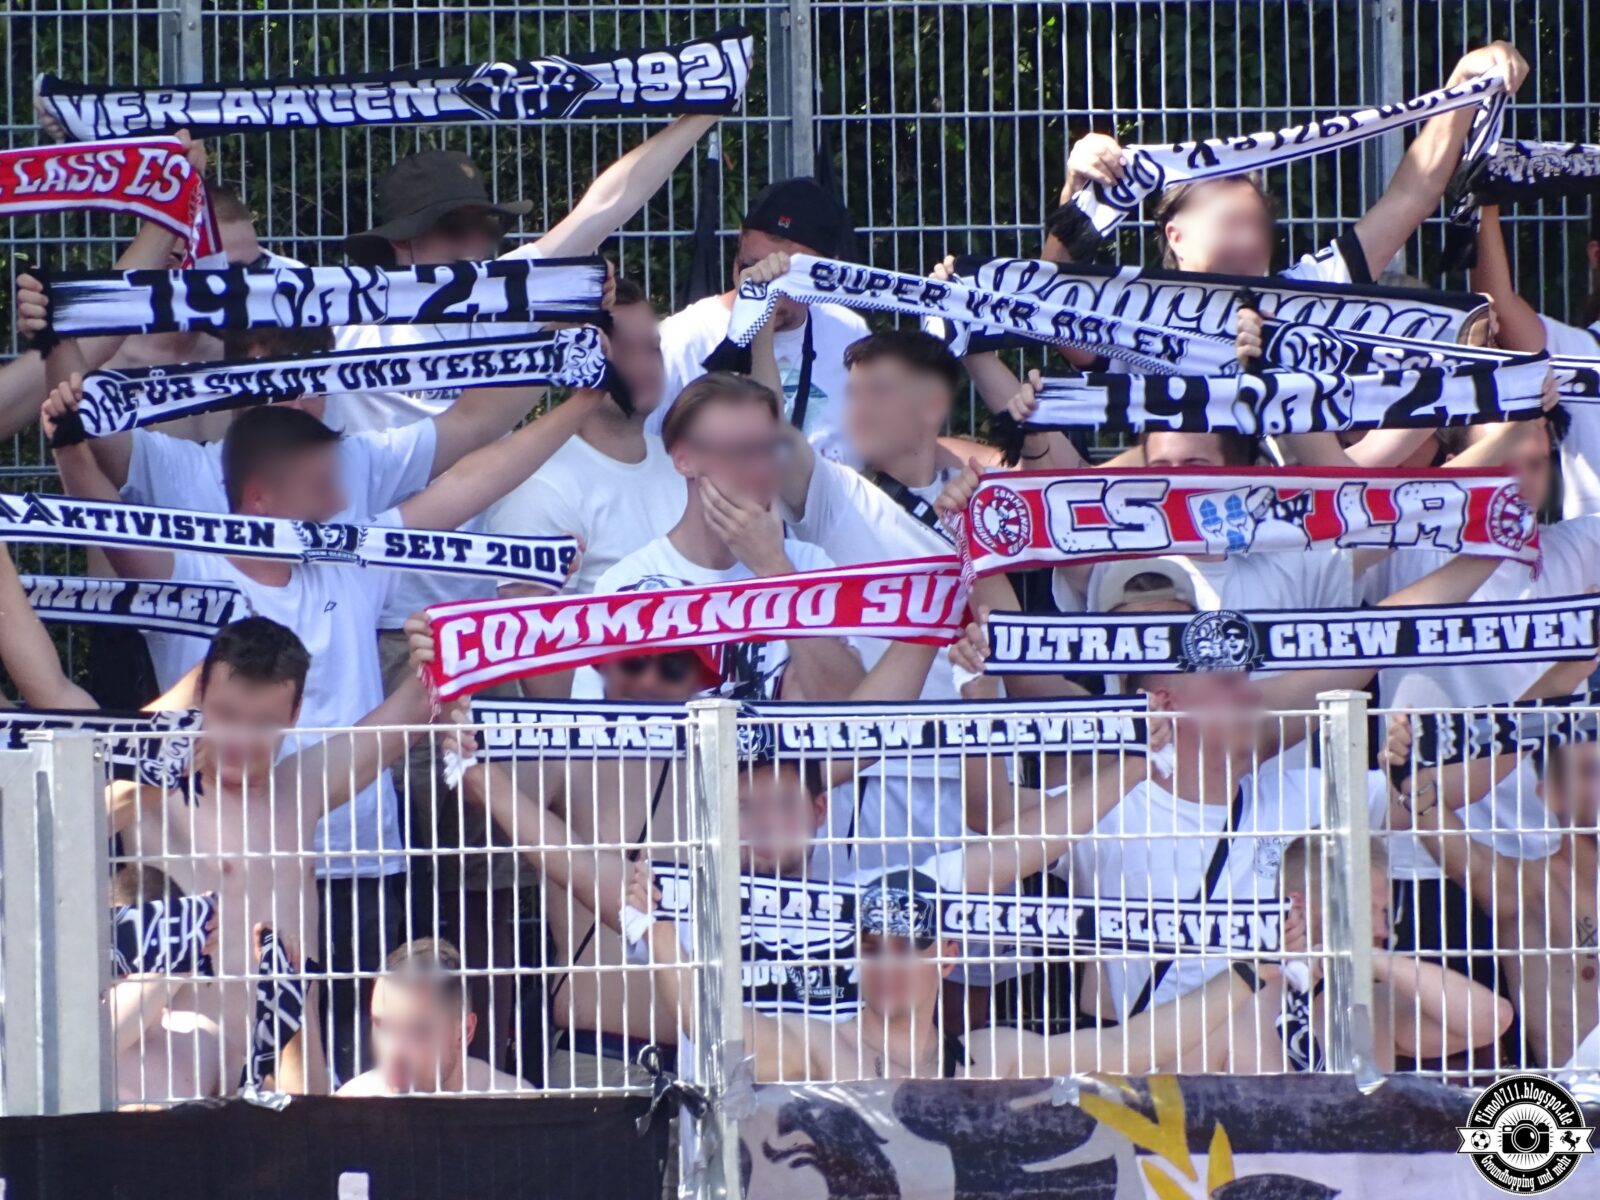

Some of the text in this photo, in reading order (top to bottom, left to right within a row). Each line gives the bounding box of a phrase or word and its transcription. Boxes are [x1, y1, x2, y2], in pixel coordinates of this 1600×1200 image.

[219, 79, 440, 127] AALEN
[612, 38, 750, 103] 1921
[14, 147, 191, 202] LASS ES
[124, 267, 250, 334] 19
[408, 259, 532, 324] 21
[810, 260, 952, 311] SUPER
[1051, 308, 1192, 365] AALEN
[203, 363, 332, 398] STADT
[337, 357, 412, 391] UND
[418, 342, 567, 382] VEREIN
[1084, 371, 1209, 432] 19
[1377, 361, 1506, 427] 21
[384, 531, 472, 563] SEIT
[1044, 478, 1468, 554] CS LA
[130, 582, 243, 625] ELEV
[439, 581, 843, 677] COMMANDO
[994, 624, 1171, 662] ULTRAS
[1269, 620, 1401, 658] CREW
[1414, 609, 1595, 656] ELEVEN
[480, 709, 1136, 749] ULTRAS CREW ELEVEN
[660, 875, 844, 921] URAS
[944, 902, 1083, 937] CREW
[1100, 910, 1280, 951] ELEVEN
